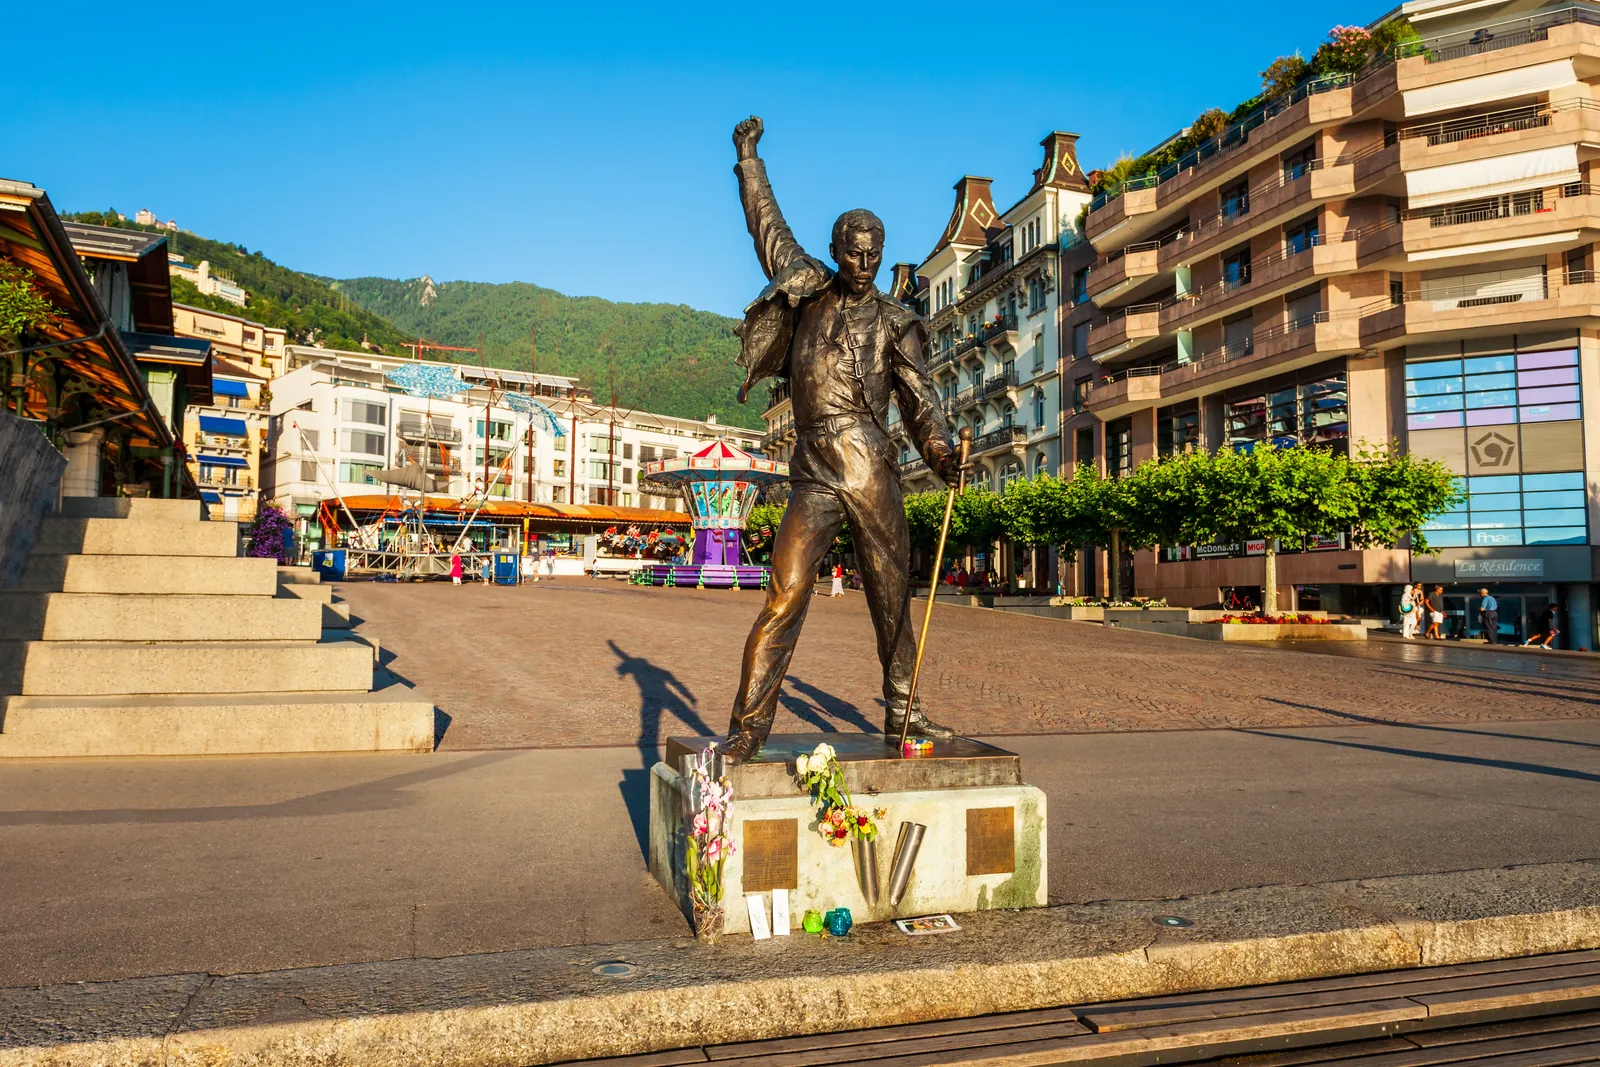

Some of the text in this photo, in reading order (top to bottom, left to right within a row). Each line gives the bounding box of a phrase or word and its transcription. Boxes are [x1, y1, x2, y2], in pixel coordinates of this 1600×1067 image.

[1476, 532, 1517, 543] fnac
[1247, 543, 1266, 551] MIGR
[1459, 560, 1540, 573] La Résidence
